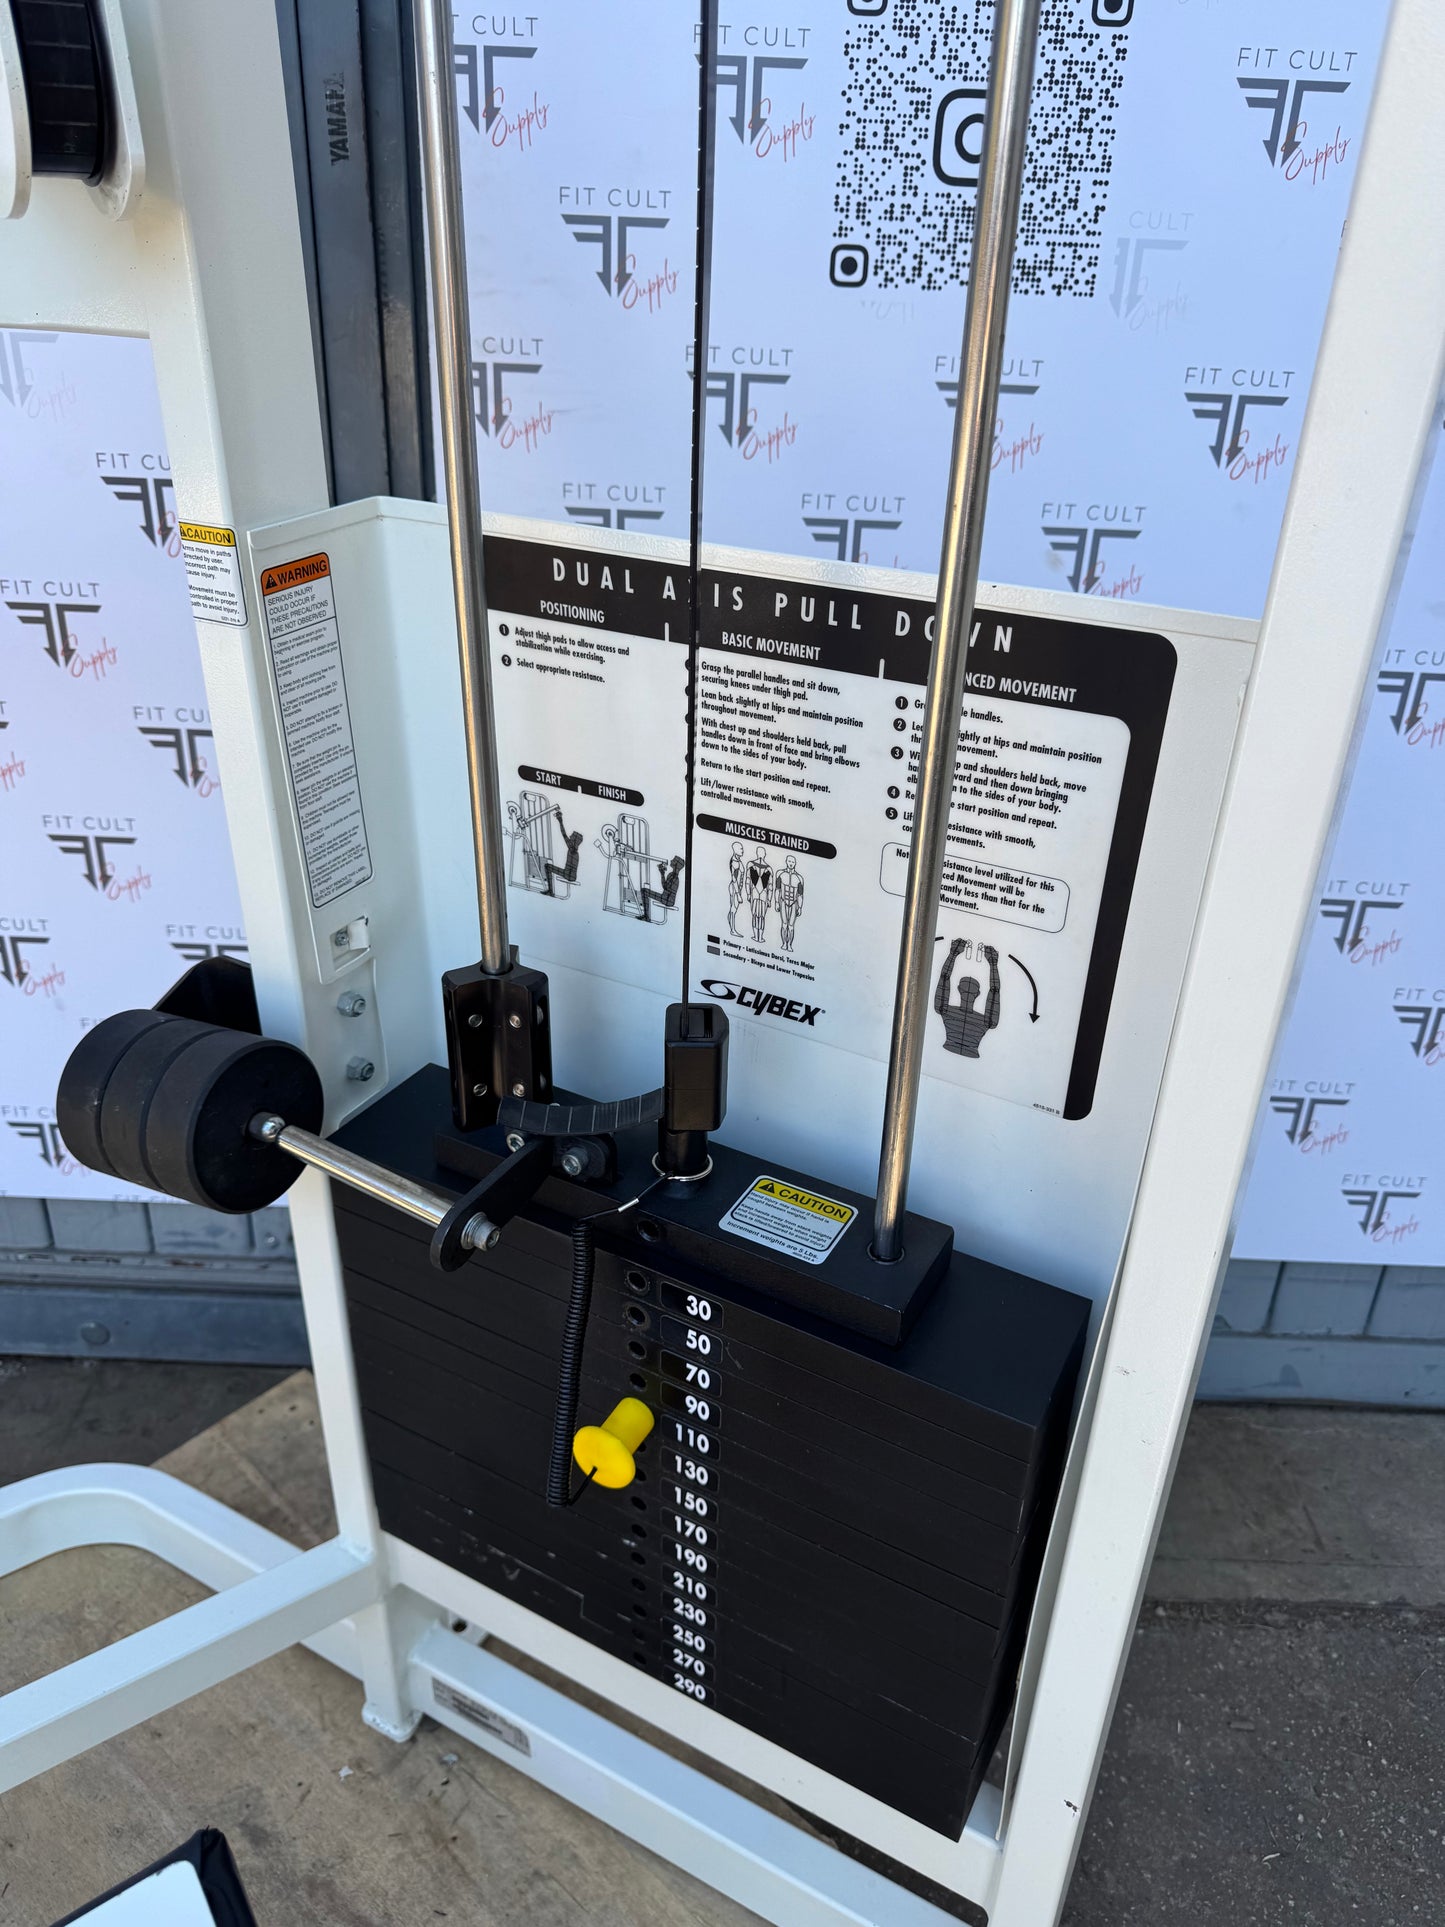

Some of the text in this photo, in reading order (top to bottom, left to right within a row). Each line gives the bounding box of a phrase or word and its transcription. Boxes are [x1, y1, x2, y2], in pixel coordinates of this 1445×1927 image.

[472, 16, 538, 37] CULT
[693, 24, 811, 48] FT CULT
[1238, 48, 1357, 73] FIT CULT
[325, 72, 349, 166] YAMA
[482, 87, 550, 150] Supply
[749, 98, 816, 162] Supply
[1283, 121, 1351, 185] Supply
[560, 187, 672, 210] FIT CULT
[615, 254, 679, 313] Supply
[482, 337, 544, 356] CULT
[686, 346, 793, 366] FT CULT
[1185, 367, 1295, 389] FIT CULT
[492, 397, 554, 453] Supply
[737, 408, 798, 463] Supply
[96, 452, 129, 470] FIT
[1227, 430, 1289, 484] Supply
[562, 483, 667, 503] FIT CULT
[802, 494, 904, 514] FIT CULT
[1041, 503, 1147, 524] FIT CULT
[187, 528, 231, 543] CAUTION
[277, 560, 327, 585] WARNING
[1, 579, 100, 599] FIT CULT
[268, 585, 313, 606] SERIOUS INJURY
[553, 558, 634, 594] DUAL
[663, 576, 743, 611] AIS
[775, 592, 861, 630] PULL
[269, 597, 309, 615] COULD OCCUR
[540, 600, 604, 623] POSITIONING
[514, 626, 629, 655] Adjust thigh pads to allow access and
[515, 638, 605, 664] stabilization while exercising.
[722, 632, 821, 660] BASIC MOVEMENT
[62, 633, 118, 681] Supply
[516, 657, 605, 682] Select appropriate resistance.
[701, 661, 840, 695] Grasp the parallel handles and sit down,
[701, 675, 808, 700] securing knees under thigh pad.
[964, 672, 1077, 703] NCED MOVEMENT
[701, 688, 863, 727] Lean back slightly at hips and maintain position
[701, 701, 776, 723] throughout movement.
[969, 708, 1003, 723] handles.
[701, 738, 806, 770] down to the sides of your body.
[982, 735, 1102, 764] at hips and maintain position
[536, 771, 626, 800] START FINISH
[700, 757, 830, 793] Return to the start position and repeat.
[700, 777, 814, 811] Lift/lower resistance with smooth,
[700, 789, 772, 811] controlled movements.
[42, 814, 136, 832] FIT CULT
[725, 822, 809, 851] MUSCLES TRAINED
[956, 873, 1025, 897] Movement will be
[974, 865, 1054, 891] level utilized for this
[1355, 881, 1410, 897] CULT
[736, 986, 821, 1026] CYBEX
[1342, 1174, 1428, 1188] FIT CULT
[779, 1189, 847, 1219] CAUTION
[727, 1221, 760, 1237] Increment
[760, 1233, 786, 1247] weights
[686, 1295, 711, 1321] 30
[686, 1329, 710, 1355] 50
[685, 1363, 710, 1389] 70
[685, 1395, 710, 1421] 90
[675, 1423, 709, 1453] 110
[675, 1456, 708, 1485] 130
[674, 1486, 707, 1516] 150
[674, 1515, 707, 1544] 170
[675, 1544, 707, 1572] 190
[673, 1571, 706, 1600] 210
[673, 1597, 706, 1626] 230
[673, 1624, 706, 1652] 250
[673, 1649, 705, 1676] 270
[674, 1673, 706, 1700] 290
